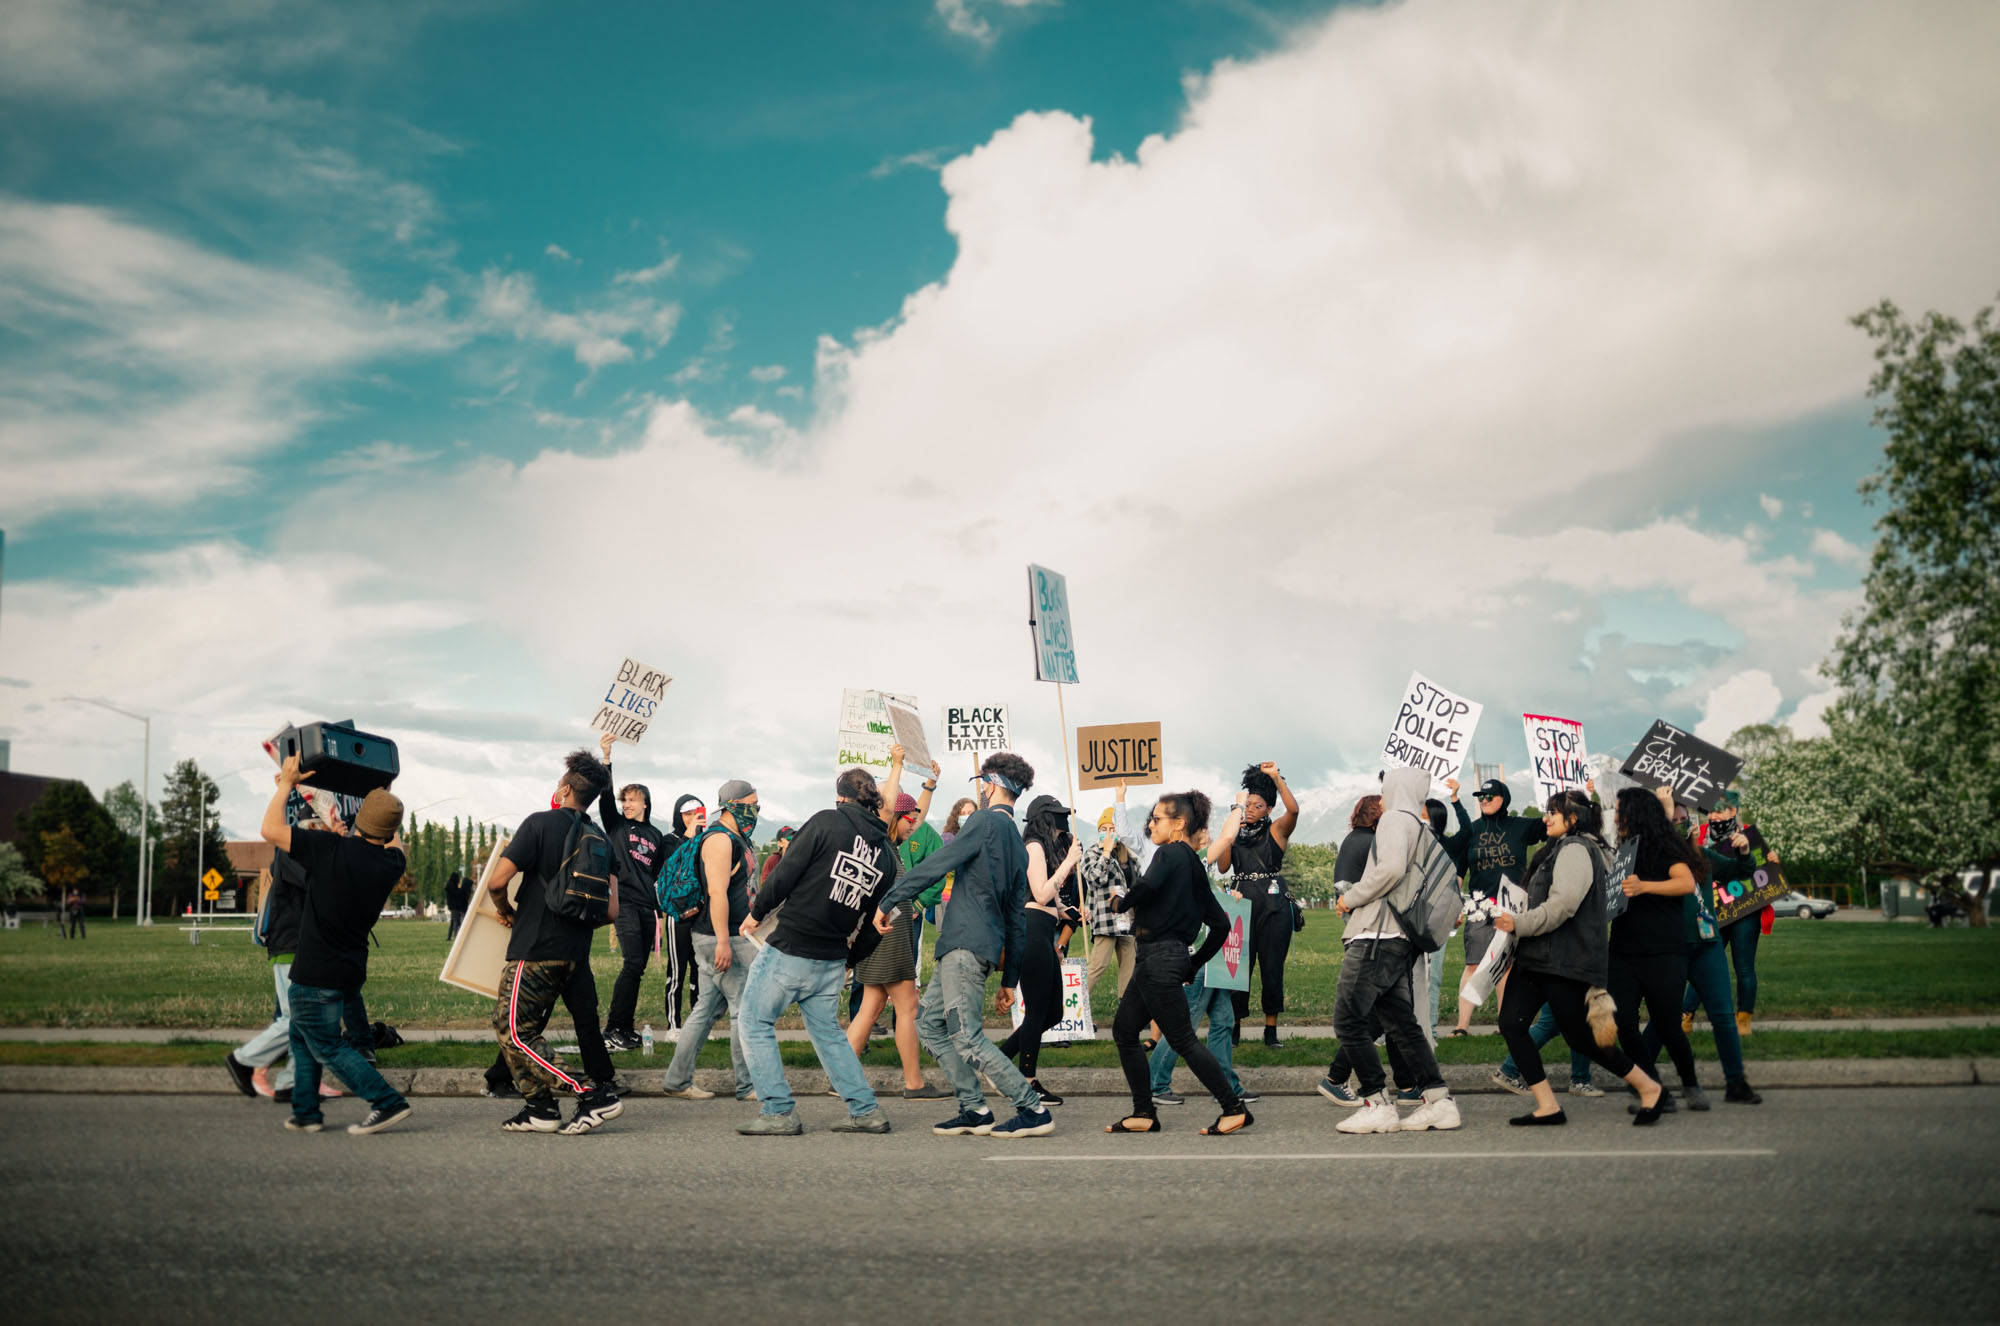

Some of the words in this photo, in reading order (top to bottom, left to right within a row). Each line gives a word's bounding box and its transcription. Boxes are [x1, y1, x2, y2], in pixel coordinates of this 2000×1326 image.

[617, 659, 673, 701] BLACK
[604, 683, 658, 718] LIVES
[1411, 682, 1470, 724] STOP
[592, 707, 648, 743] MATTER
[948, 707, 1004, 725] BLACK
[948, 725, 1005, 738] LIVES
[1395, 703, 1464, 752] POLICE
[948, 739, 1009, 752] MATTER
[1536, 727, 1580, 753] STOP
[1081, 738, 1158, 773] JUSTICE
[1385, 733, 1460, 781] BRUTALITY
[1535, 756, 1590, 784] KILLING
[852, 835, 882, 867] OBEY
[1473, 843, 1511, 859] THEIR
[1479, 832, 1507, 848] SAY
[1477, 856, 1517, 871] NAMES
[1228, 931, 1240, 947] NO
[1224, 946, 1241, 965] HATE
[1064, 973, 1081, 988] Is
[1065, 992, 1078, 1009] of
